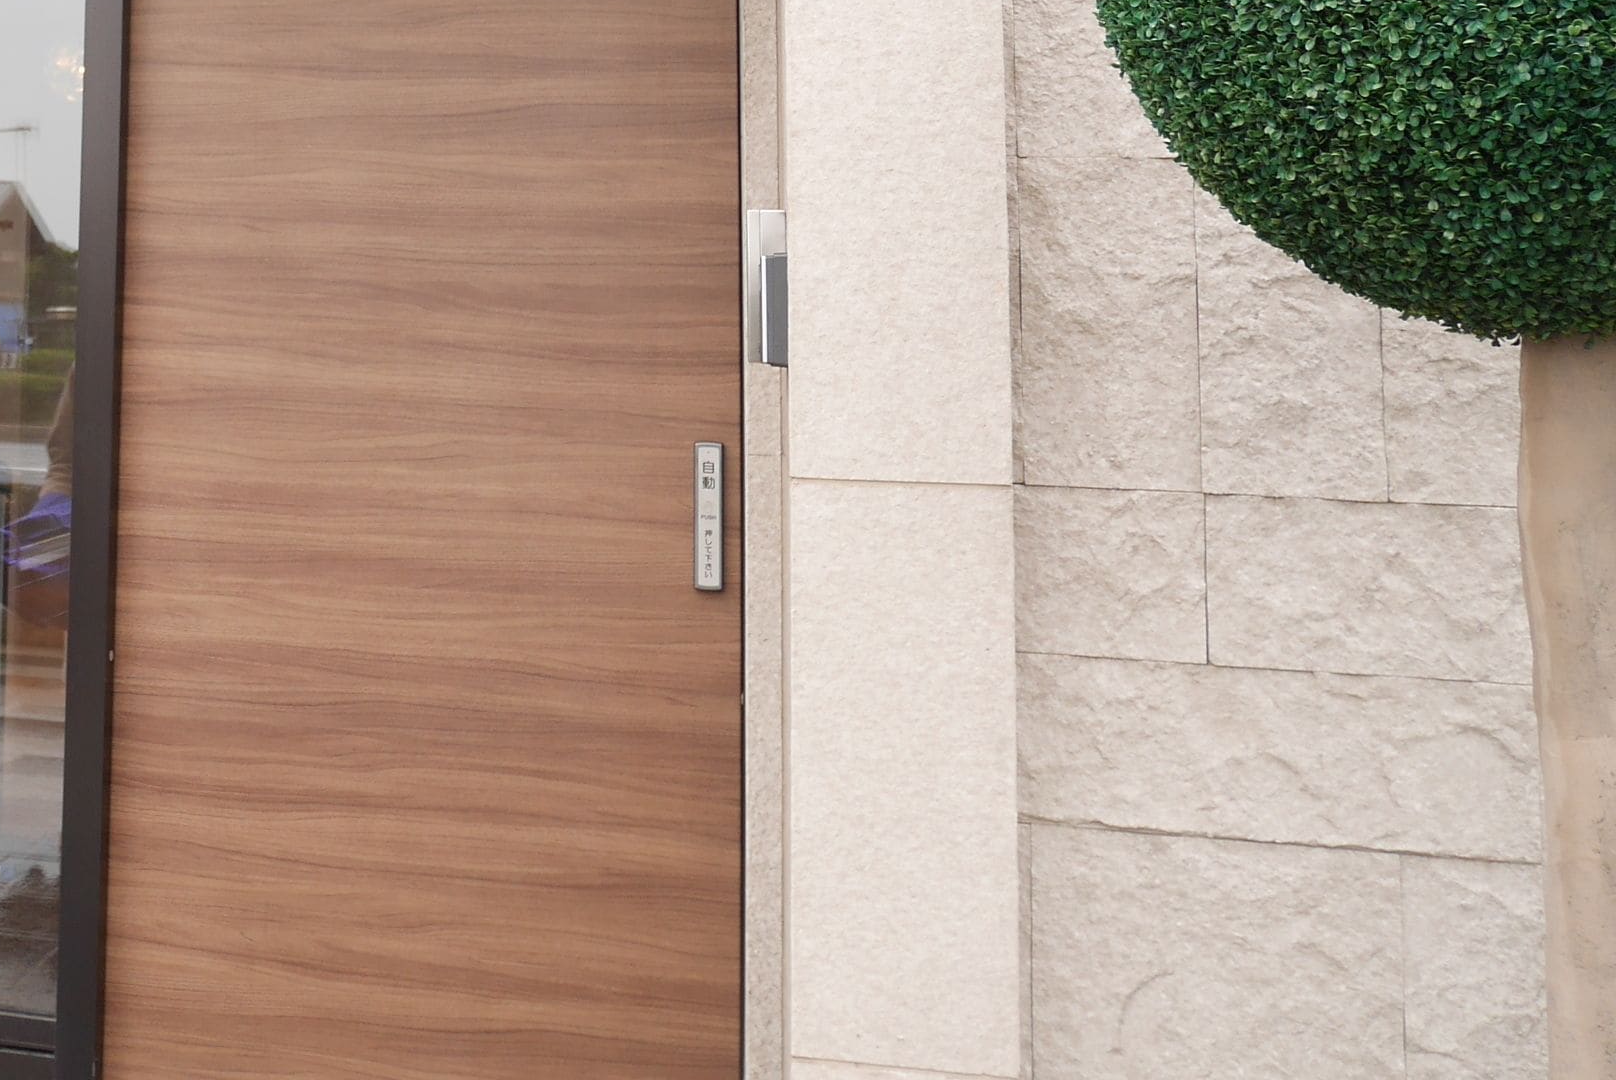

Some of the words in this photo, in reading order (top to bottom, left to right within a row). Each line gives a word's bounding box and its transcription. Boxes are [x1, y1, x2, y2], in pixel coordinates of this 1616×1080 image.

[702, 461, 716, 490] 自動
[704, 529, 713, 579] 押して下さい
